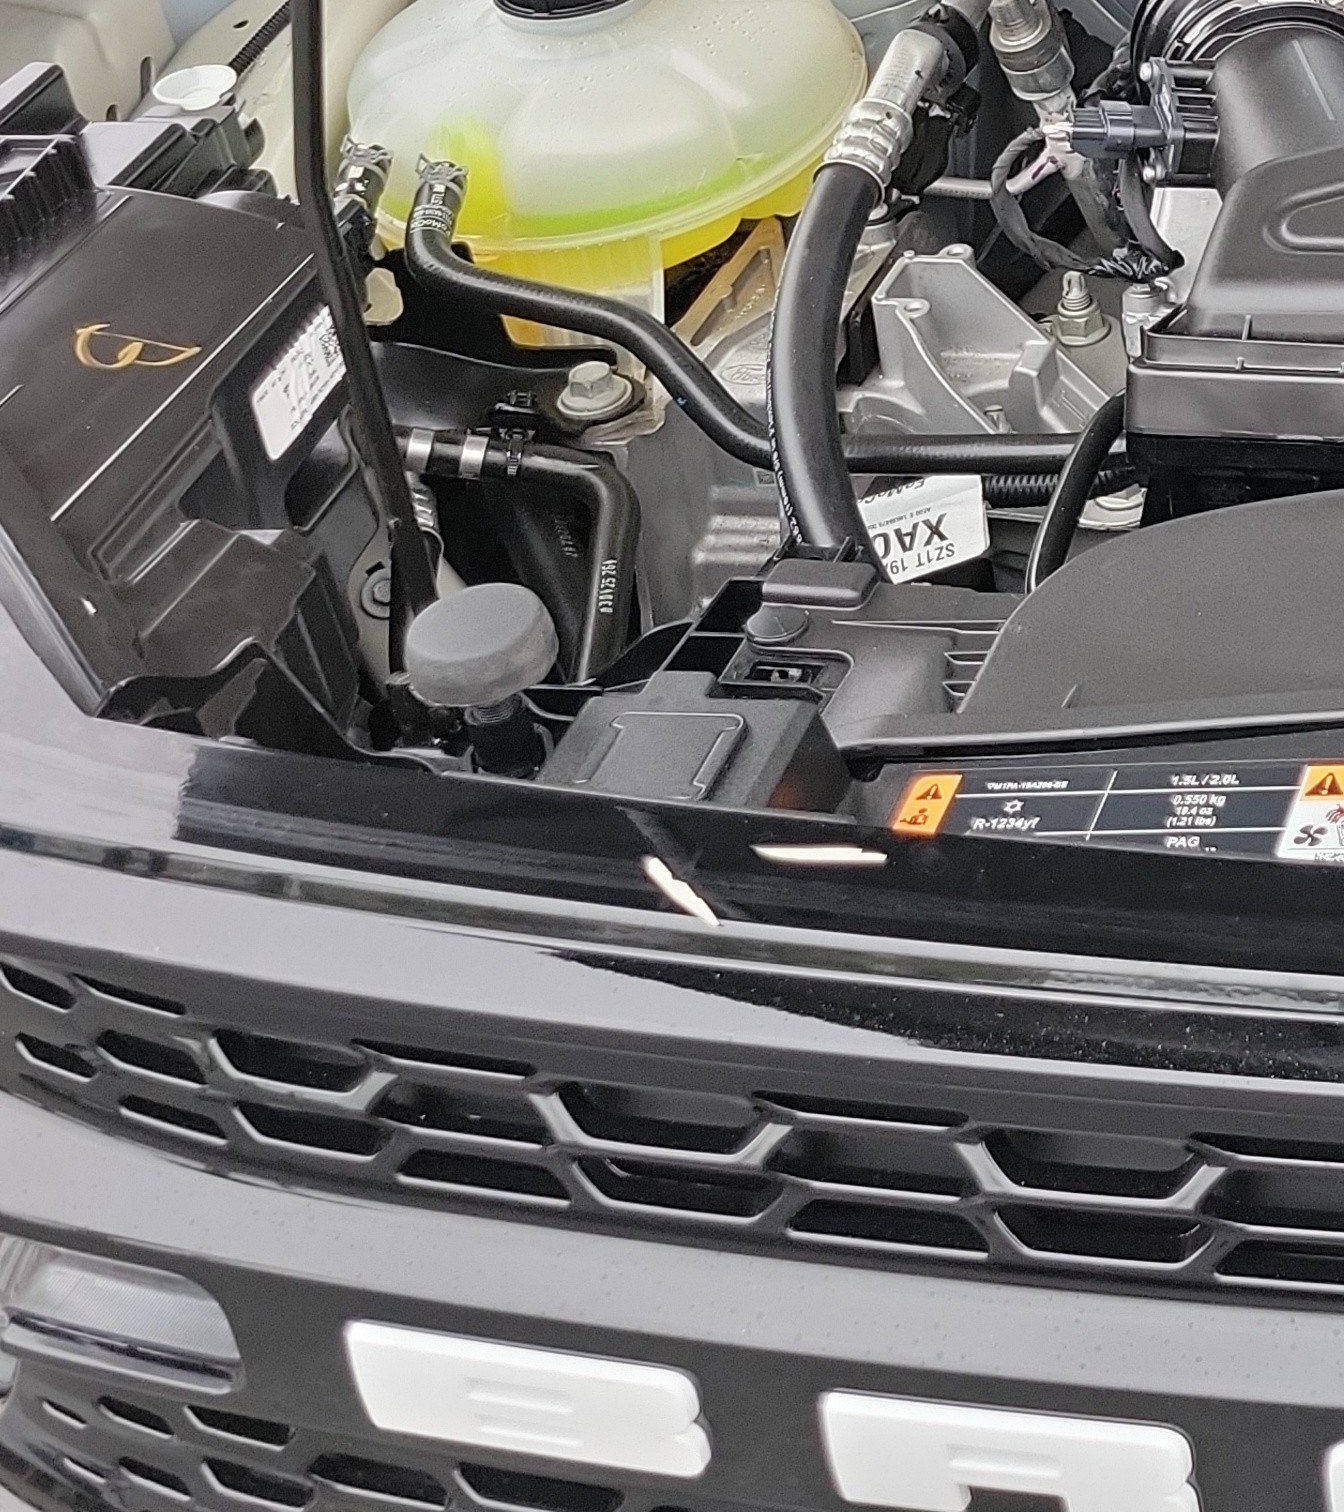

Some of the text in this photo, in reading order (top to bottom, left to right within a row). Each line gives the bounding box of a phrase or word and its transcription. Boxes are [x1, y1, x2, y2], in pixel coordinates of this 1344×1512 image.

[885, 543, 956, 575] SZ1T 19
[1170, 774, 1200, 786] 1.5L
[1209, 773, 1240, 785] 2.0L
[1171, 793, 1227, 807] 0.550 kg
[971, 816, 1041, 832] R-1234yf
[1166, 815, 1217, 828] (1.21 lbs)
[1165, 835, 1201, 849] PAG
